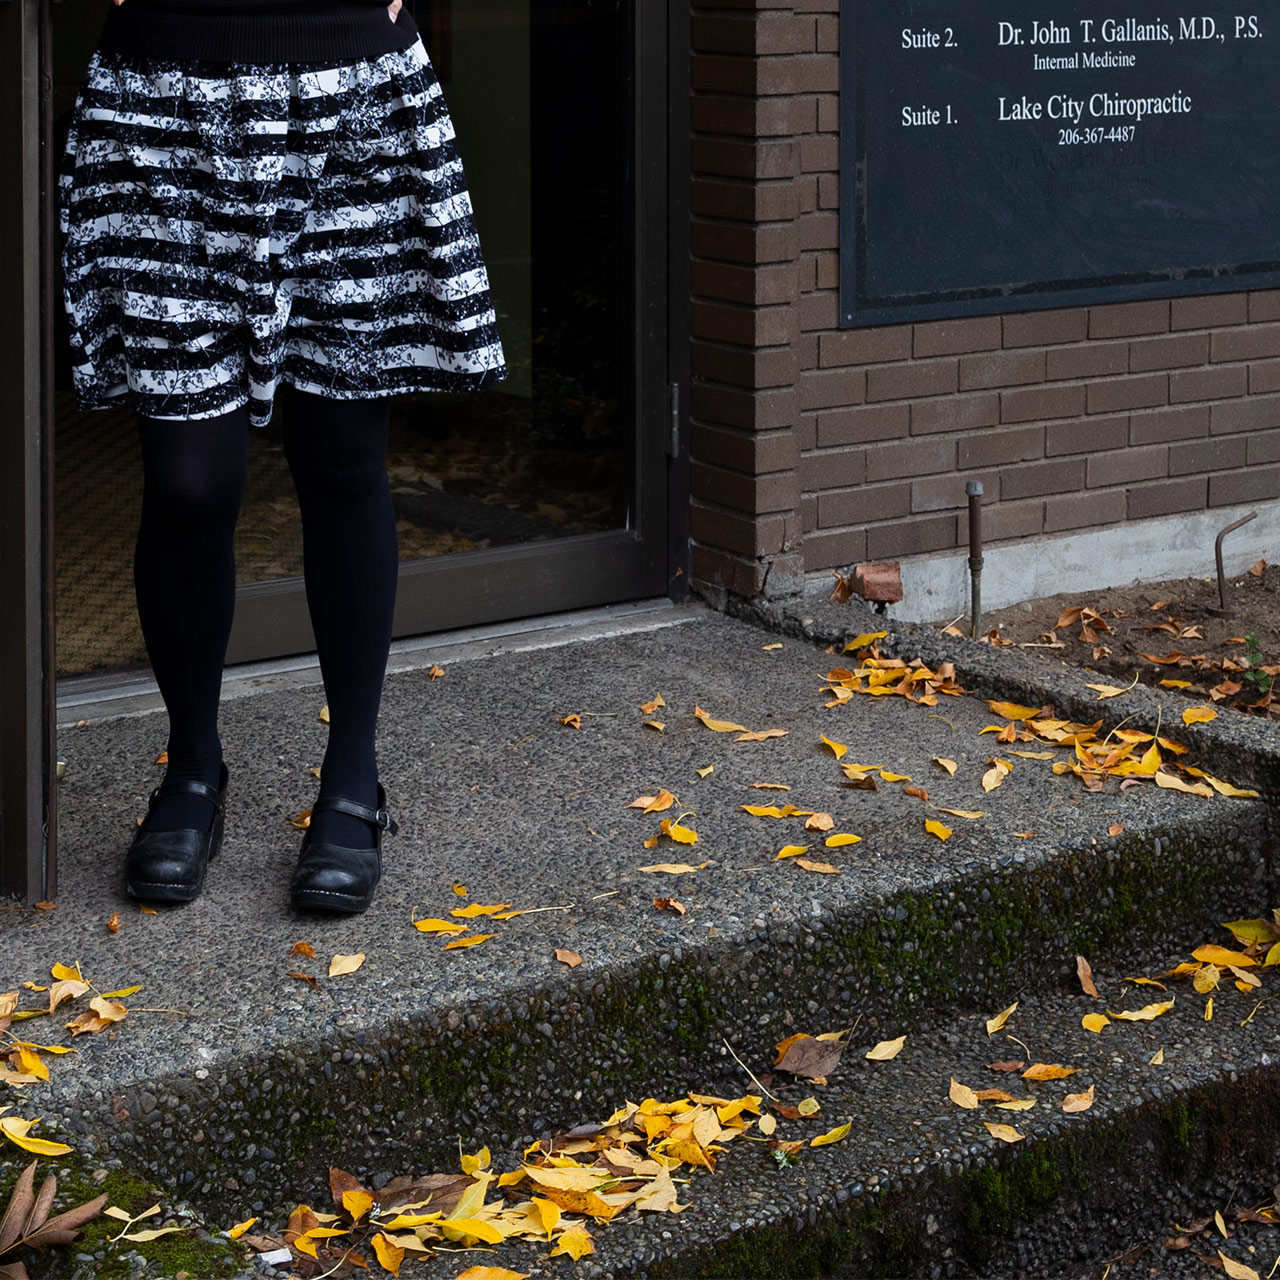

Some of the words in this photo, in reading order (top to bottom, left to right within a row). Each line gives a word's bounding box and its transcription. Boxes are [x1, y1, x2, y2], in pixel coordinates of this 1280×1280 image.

[902, 28, 940, 48] Suite
[944, 28, 958, 47] 2.
[998, 22, 1024, 45] Dr.
[1030, 20, 1070, 45] John
[1080, 20, 1096, 43] T.
[1102, 18, 1174, 44] Gallanis,
[1179, 17, 1225, 43] M.D.,
[1235, 15, 1262, 38] P.S.
[1034, 52, 1078, 70] Internal
[1082, 51, 1136, 68] Medicine
[902, 105, 940, 126] Suite
[947, 105, 958, 124] 1.
[999, 96, 1042, 120] Lake
[1047, 94, 1084, 124] City
[1089, 90, 1191, 121] Chiropractic
[1059, 126, 1135, 145] 206-367-4487
